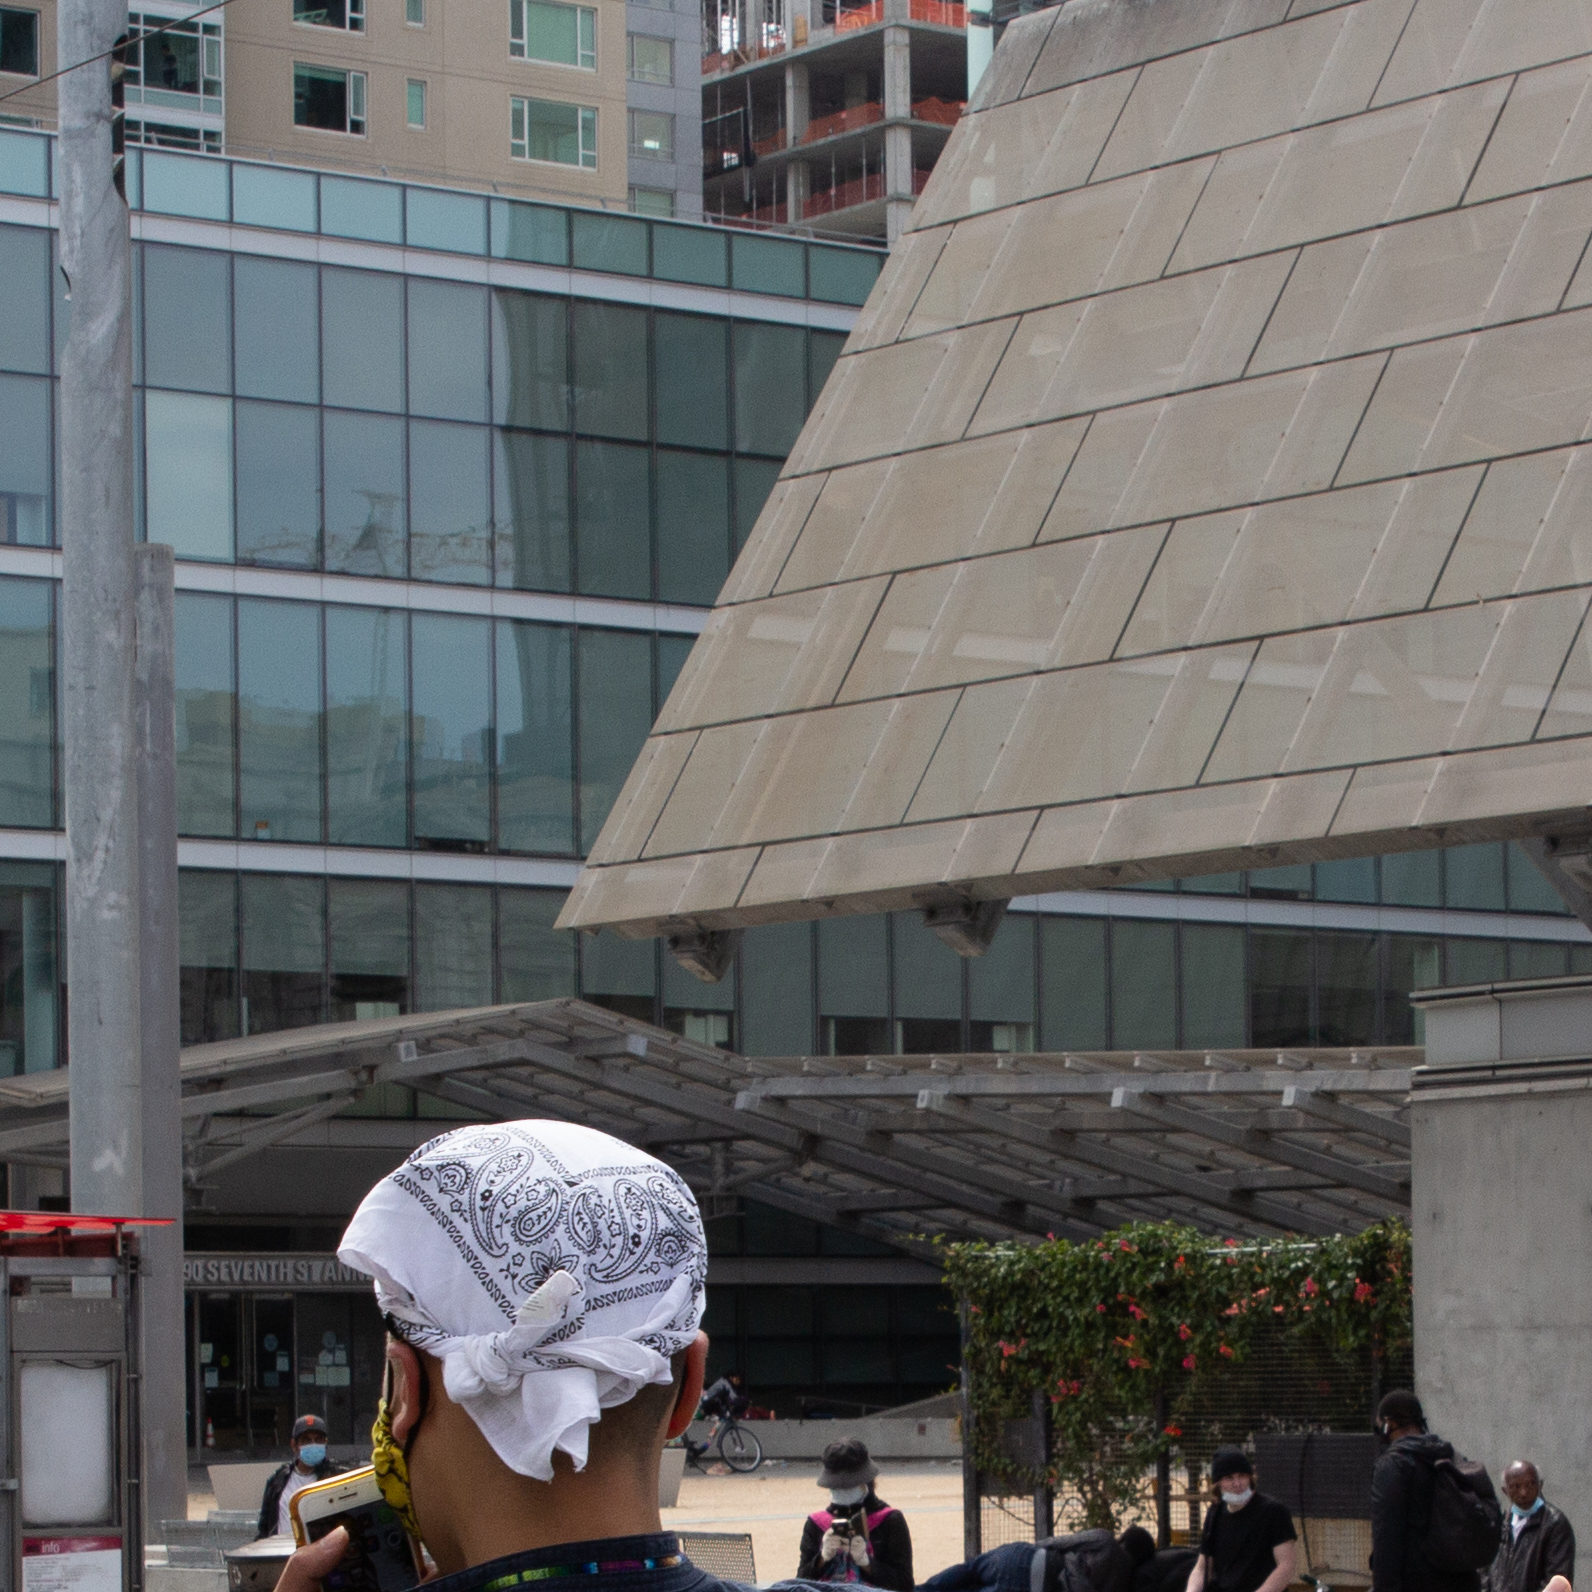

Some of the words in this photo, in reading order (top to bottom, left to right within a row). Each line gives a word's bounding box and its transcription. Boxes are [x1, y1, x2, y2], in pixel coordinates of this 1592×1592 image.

[207, 1259, 293, 1282] SEVENTH
[294, 1259, 323, 1282] ST
[41, 1540, 60, 1553] info
